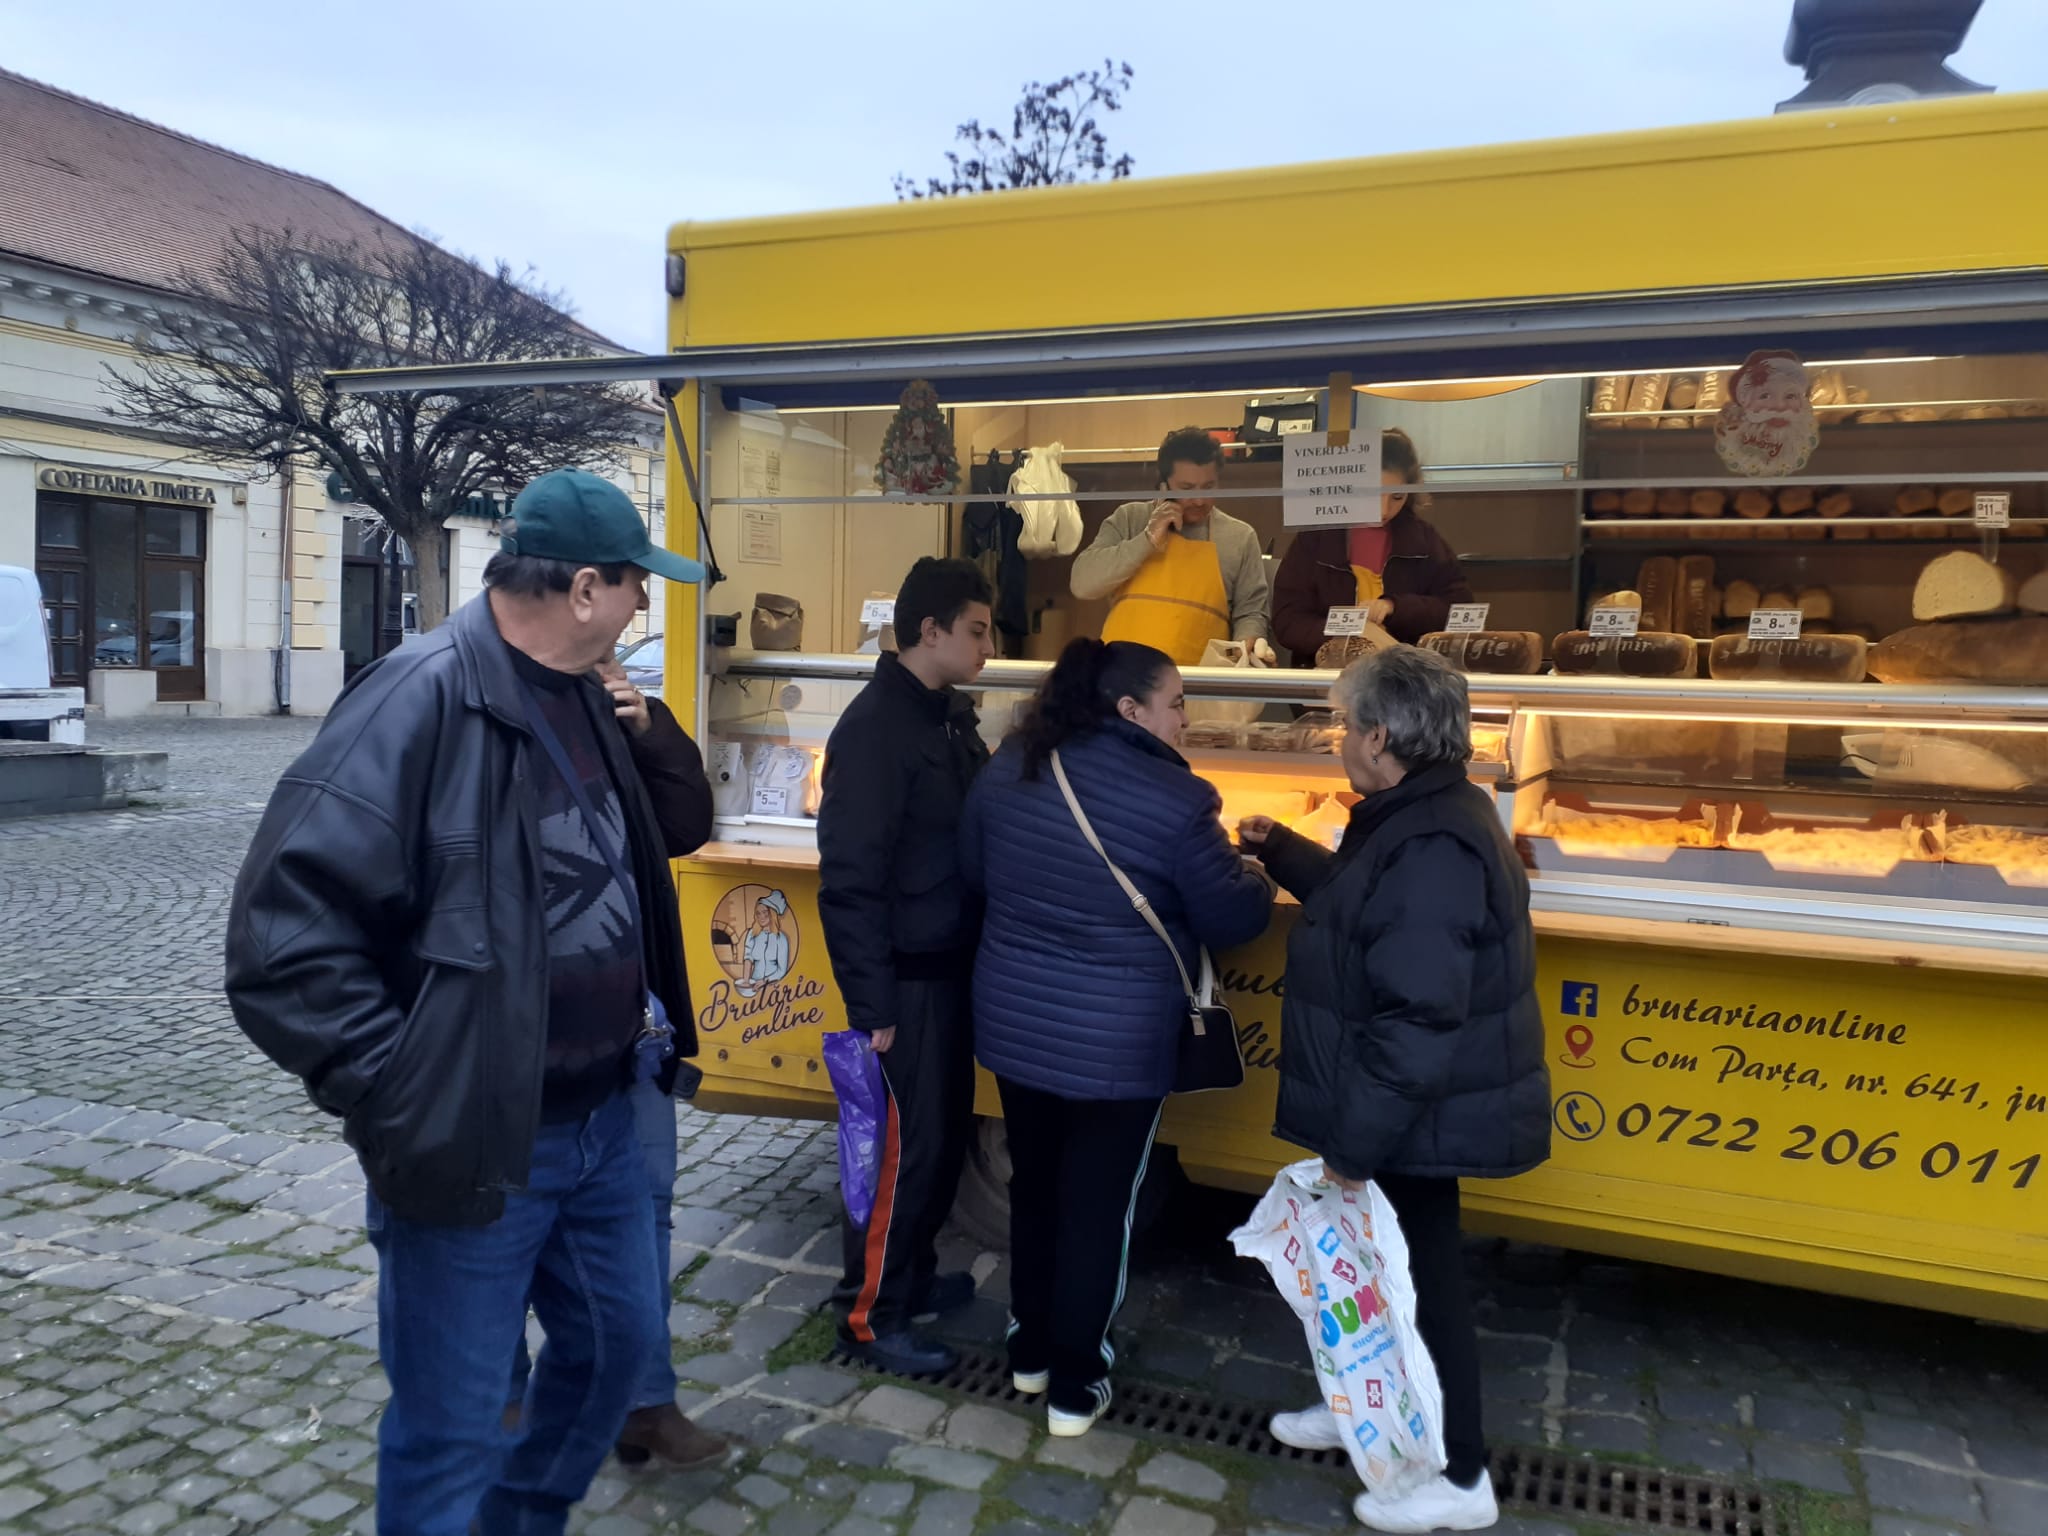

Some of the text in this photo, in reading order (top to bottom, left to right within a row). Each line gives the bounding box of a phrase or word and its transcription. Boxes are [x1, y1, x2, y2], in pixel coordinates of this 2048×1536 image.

[1294, 446, 1334, 457] VINERI
[1358, 443, 1370, 454] 30
[1297, 464, 1367, 477] DECEMBRIE
[40, 468, 148, 497] COFETARIA
[1309, 484, 1353, 496] SE TINE
[1315, 505, 1348, 516] PIATA
[1342, 613, 1350, 623] 5
[1463, 612, 1470, 623] 8
[1608, 614, 1617, 626] 8
[1769, 617, 1777, 629] 8
[761, 794, 768, 805] 5
[700, 975, 824, 1032] Brutăria
[1622, 983, 1907, 1045] brutariaonline
[741, 1000, 824, 1044] online
[1620, 1036, 1698, 1072] Com
[1844, 1073, 1888, 1096] nr.
[1904, 1073, 1989, 1110] 641,
[1617, 1102, 2041, 1189] 0722 206 011
